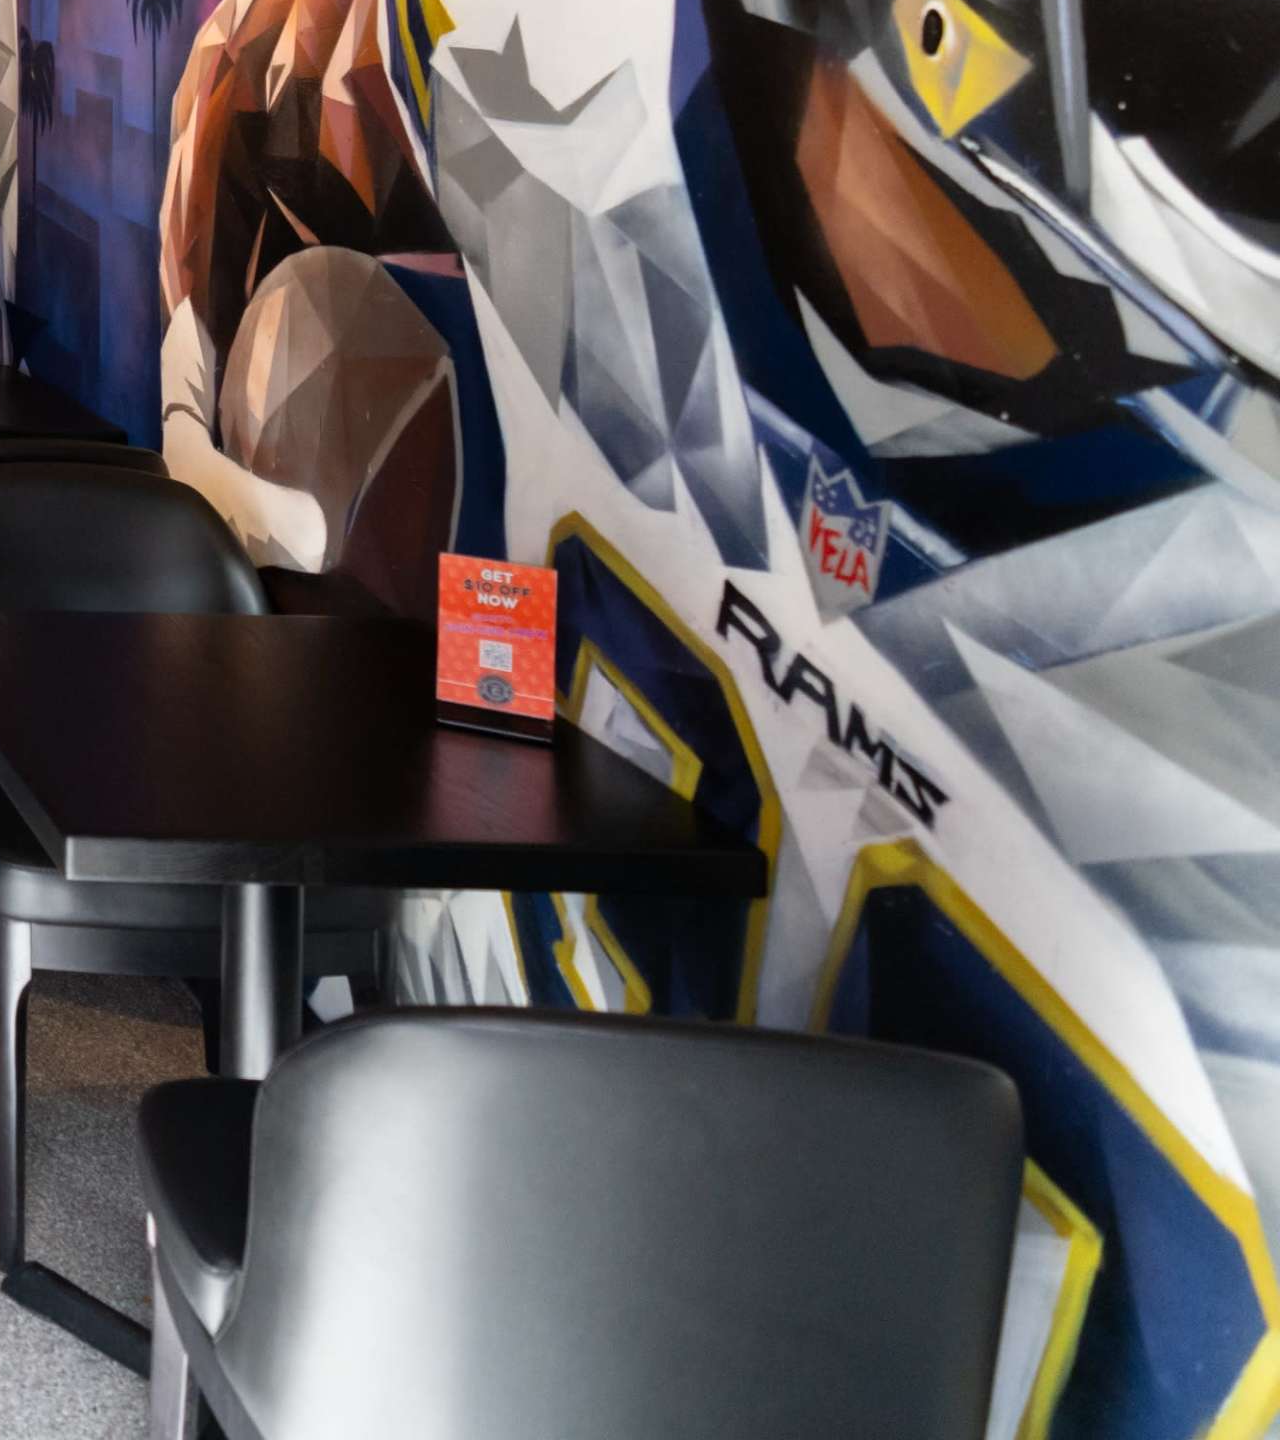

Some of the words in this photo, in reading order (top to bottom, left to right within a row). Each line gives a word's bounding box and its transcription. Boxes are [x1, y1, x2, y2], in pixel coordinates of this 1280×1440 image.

[480, 568, 514, 584] GET
[463, 579, 494, 594] $10
[498, 584, 531, 597] OFF
[477, 593, 519, 610] NOW
[715, 578, 951, 830] RAMS
